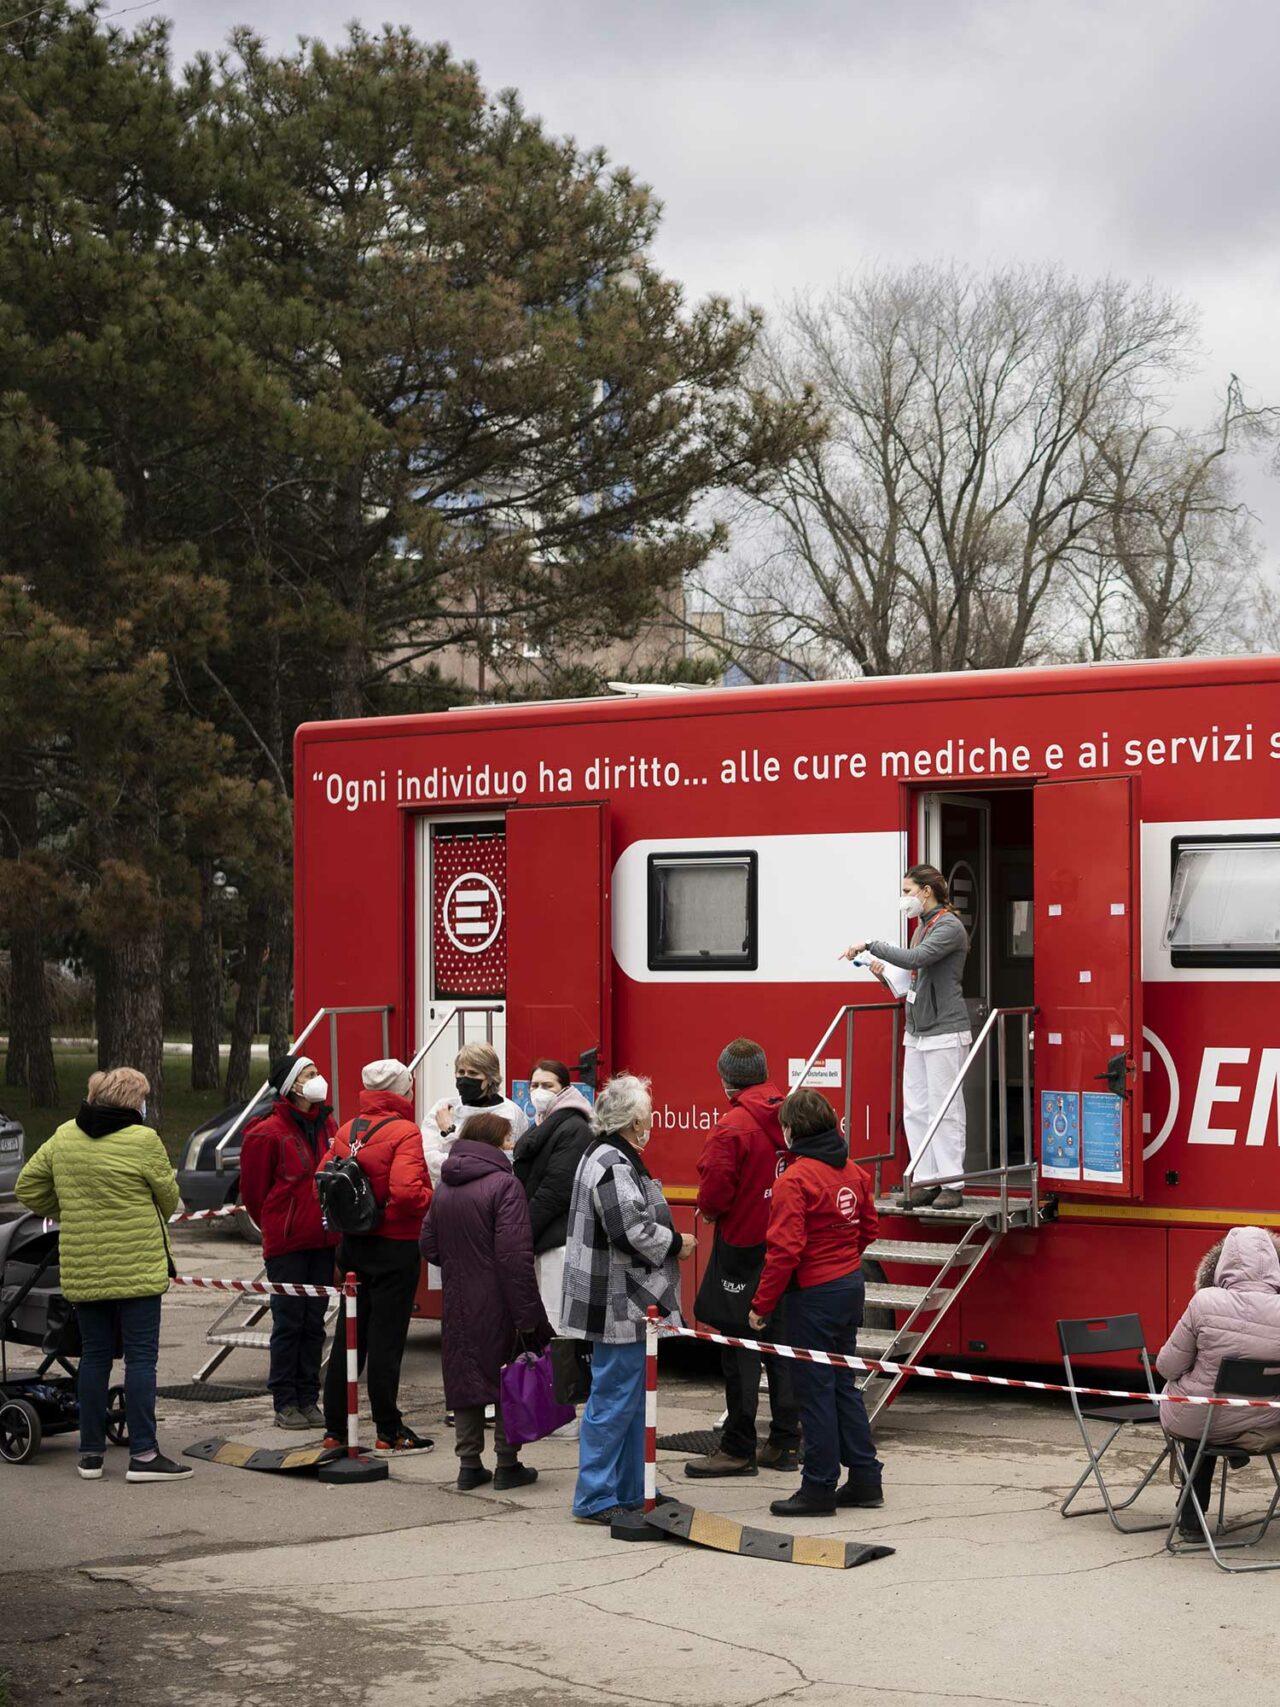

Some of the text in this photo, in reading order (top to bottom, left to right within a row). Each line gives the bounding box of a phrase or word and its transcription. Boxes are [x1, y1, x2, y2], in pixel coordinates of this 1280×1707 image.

[312, 770, 386, 812] “Ogni
[397, 764, 527, 802] individuo
[539, 760, 572, 793] ha
[584, 755, 708, 791] diritto...
[720, 749, 780, 784] alle
[793, 753, 867, 781] cure
[881, 737, 1031, 776] mediche
[1045, 743, 1064, 770] e
[1078, 731, 1109, 769] ai
[1124, 723, 1253, 767] servizi
